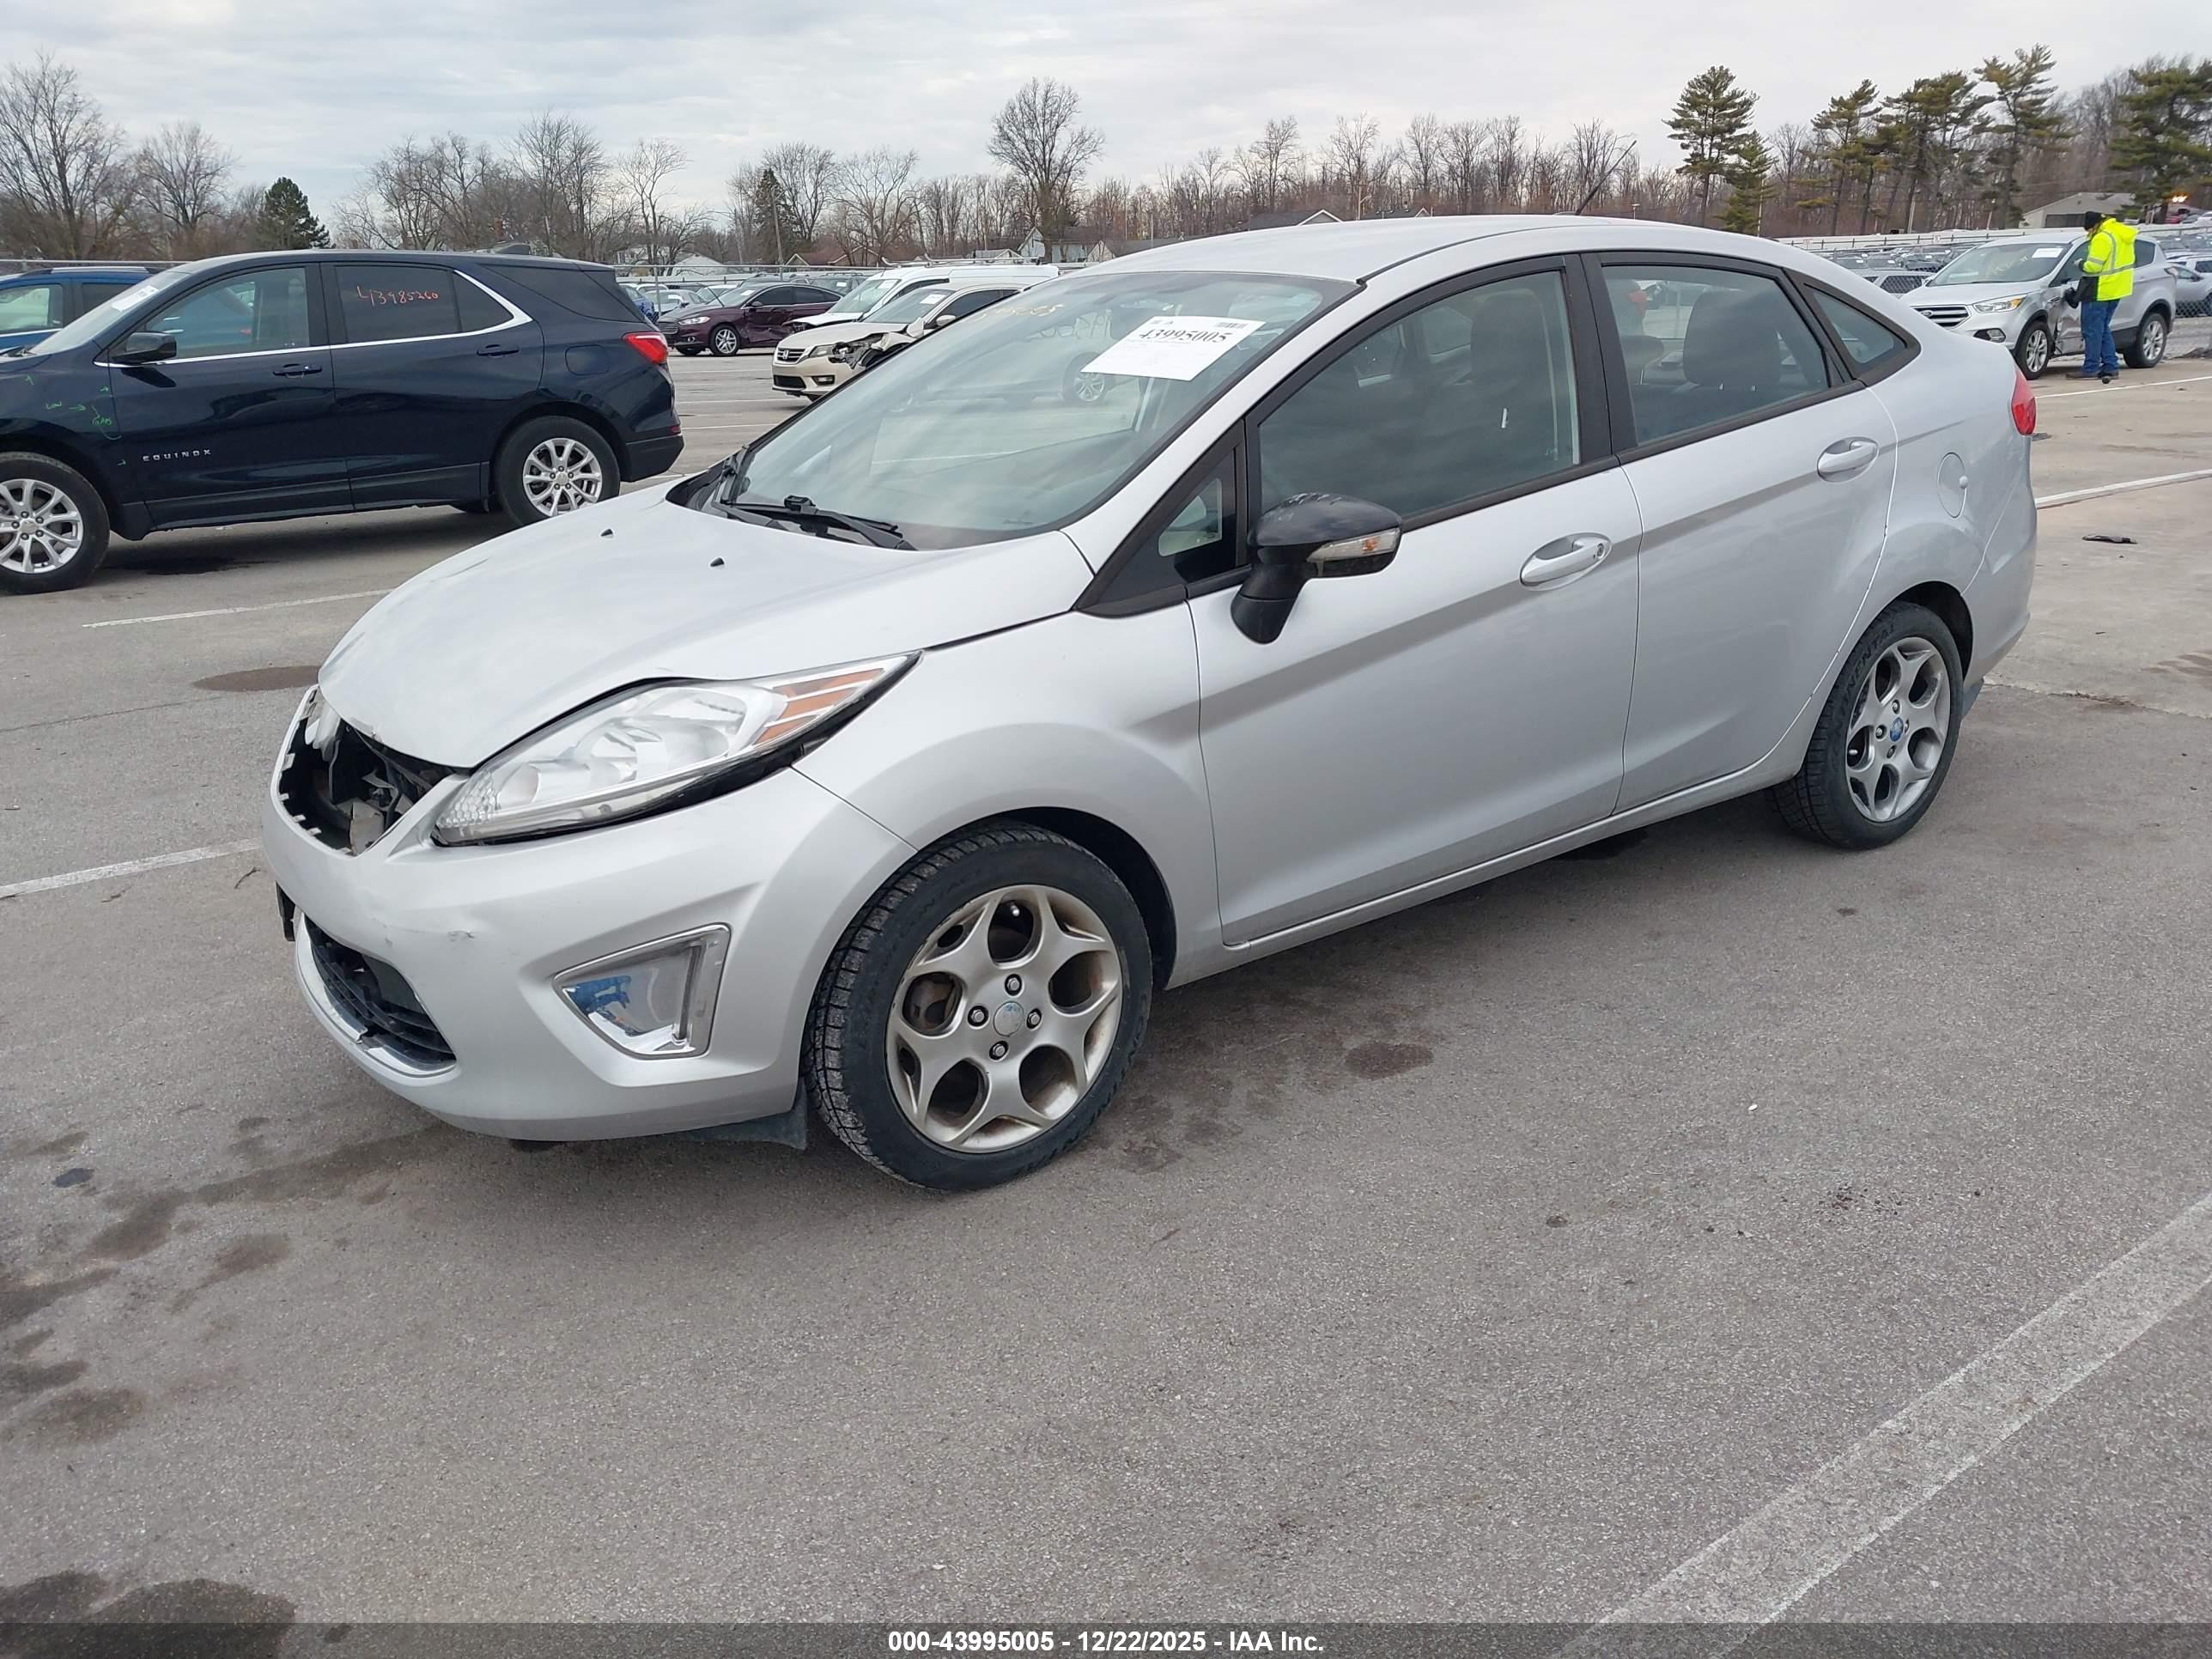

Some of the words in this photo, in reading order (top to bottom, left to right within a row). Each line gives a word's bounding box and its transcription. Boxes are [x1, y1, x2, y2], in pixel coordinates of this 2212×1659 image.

[356, 284, 440, 307] 43985260
[1139, 328, 1235, 343] 43995005
[143, 449, 211, 462] EQUINOX
